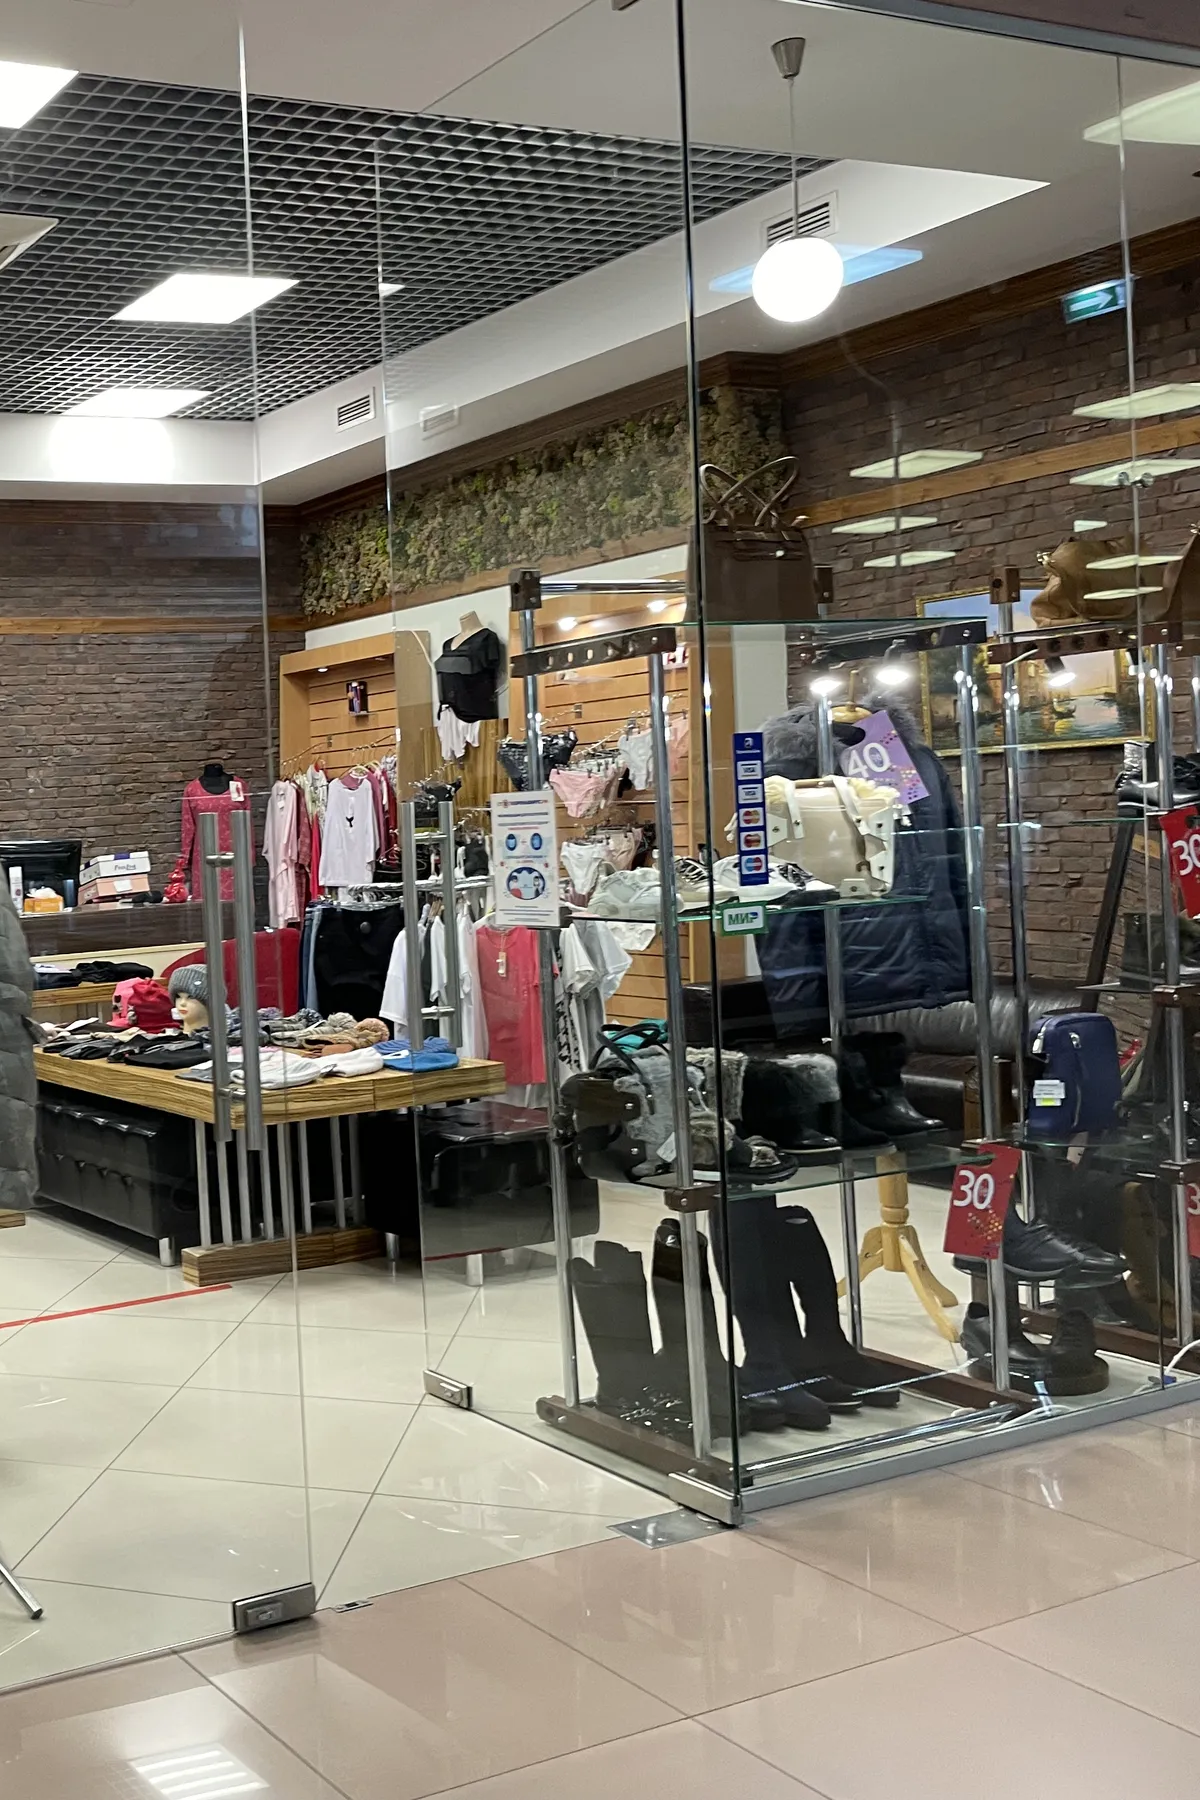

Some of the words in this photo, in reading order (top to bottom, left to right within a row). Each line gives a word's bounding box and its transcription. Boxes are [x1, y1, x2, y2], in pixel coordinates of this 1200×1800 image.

[848, 742, 891, 778] 40
[728, 911, 759, 926] МИР
[953, 1169, 996, 1210] 30
